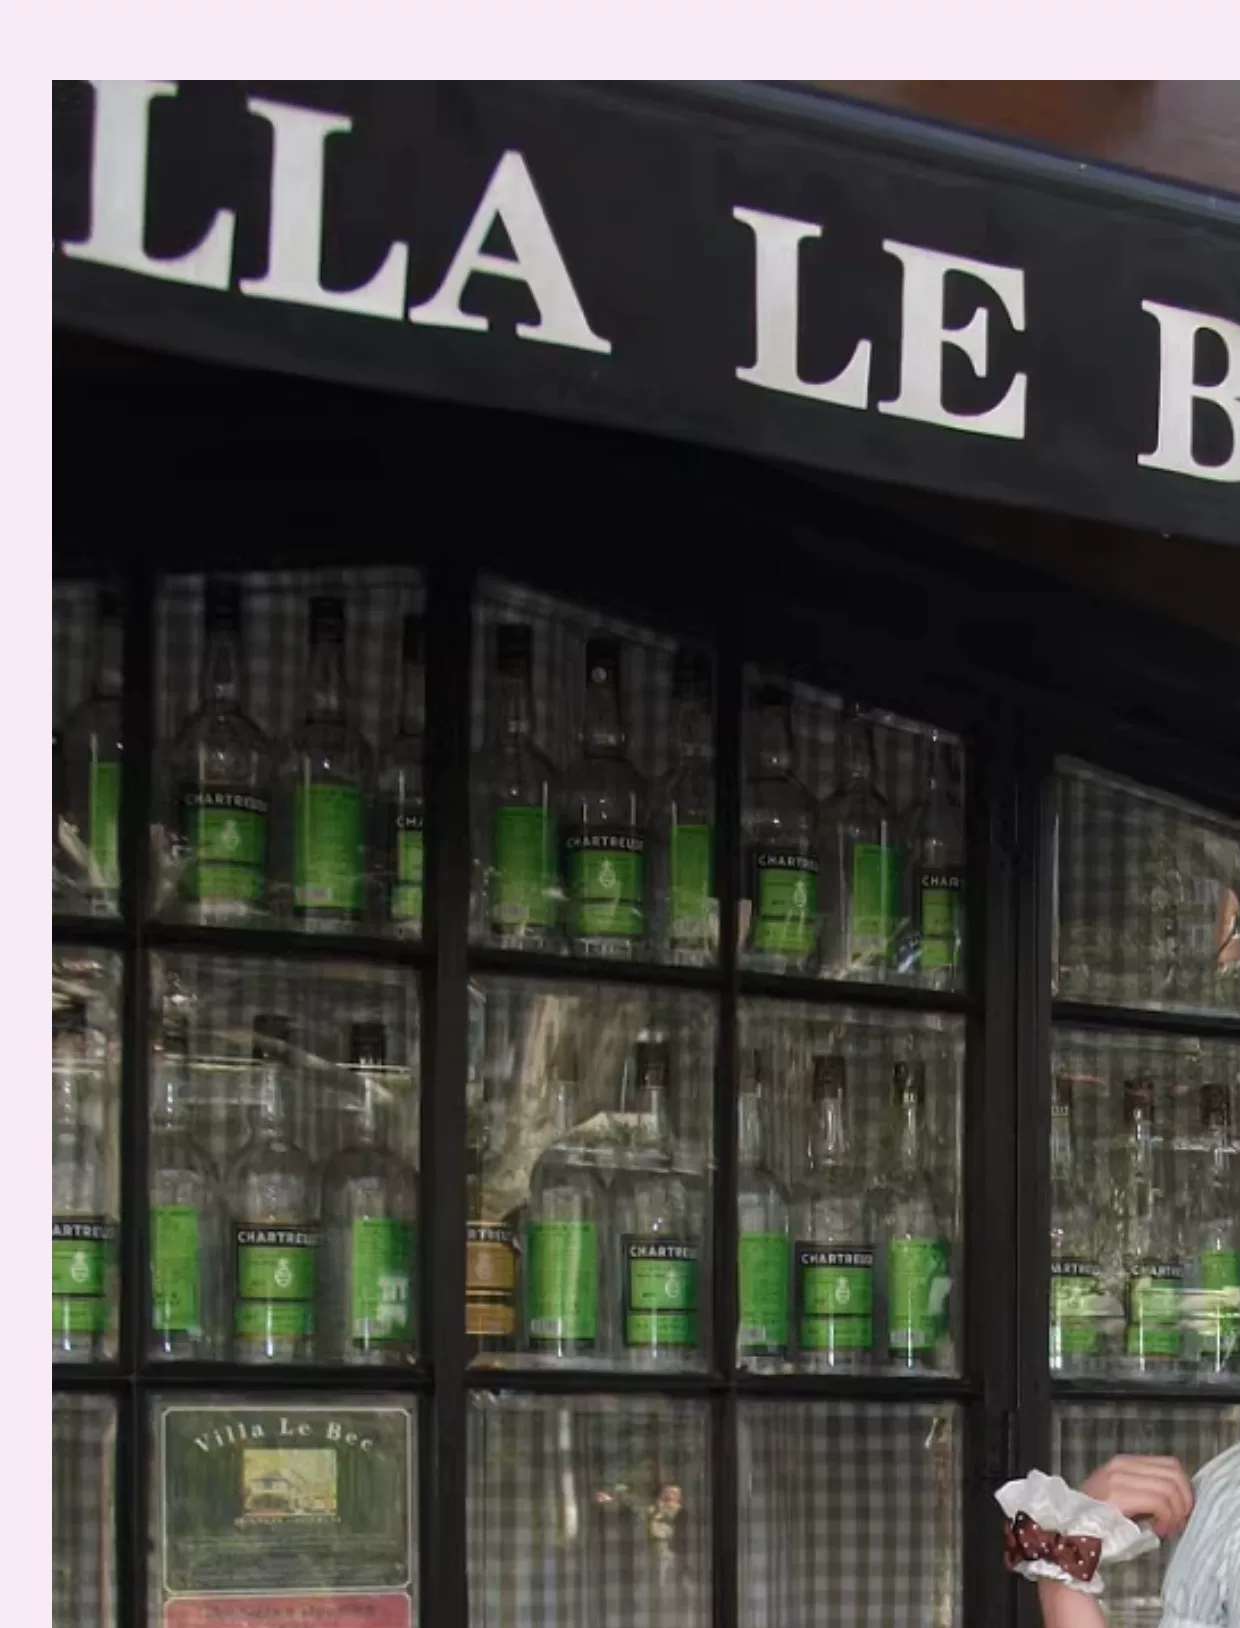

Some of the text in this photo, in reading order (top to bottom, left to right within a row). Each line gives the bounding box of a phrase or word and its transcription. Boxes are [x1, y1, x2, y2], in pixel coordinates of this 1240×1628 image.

[732, 206, 1028, 439] LE
[194, 1417, 373, 1453] Villa Le Bec
